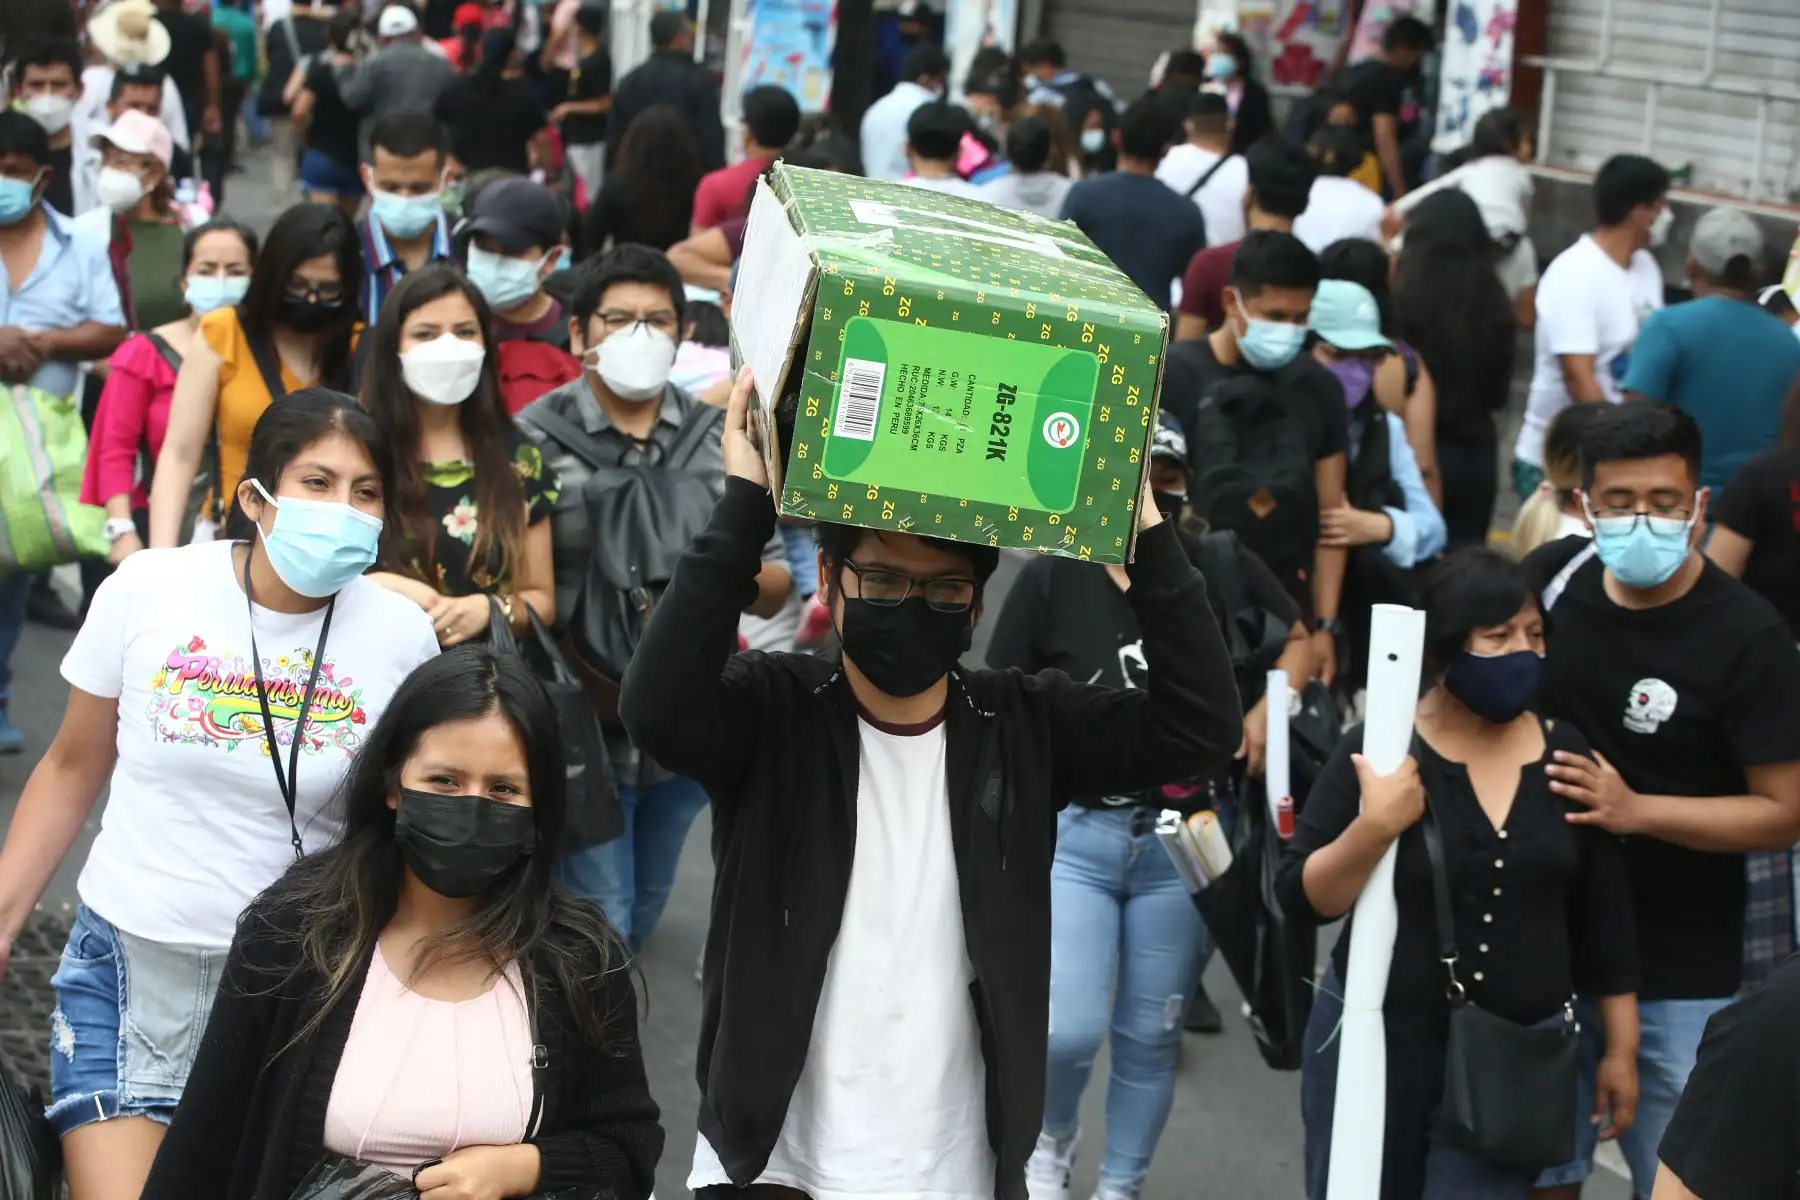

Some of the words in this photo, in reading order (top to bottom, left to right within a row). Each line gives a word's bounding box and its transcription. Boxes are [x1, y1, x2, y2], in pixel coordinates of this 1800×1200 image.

[844, 280, 854, 296] ZG
[883, 276, 896, 296] ZG
[976, 291, 984, 304] ZG
[824, 308, 832, 320] ZG
[859, 300, 869, 316] ZG
[898, 296, 911, 317] ZG
[1026, 302, 1036, 318] ZG
[1067, 304, 1078, 322] ZG
[952, 311, 959, 321] ZG
[992, 312, 1000, 324] ZG
[1041, 324, 1051, 339] ZG
[1082, 322, 1094, 343] ZG
[1134, 334, 1140, 344] ZG
[815, 350, 822, 360] ZG
[1098, 344, 1109, 364] ZG
[1149, 355, 1156, 364] ZG
[897, 364, 908, 393] HECHO
[1112, 365, 1124, 384] ZG
[895, 397, 903, 408] EN
[902, 365, 920, 435] RUC:20463689599
[962, 374, 976, 418] CANTIDAD:
[1126, 386, 1140, 406] ZG
[806, 396, 819, 417] ZG
[910, 367, 931, 451] MEDIDA:7X26X36CM
[945, 408, 952, 417] 14
[1100, 406, 1110, 422] ZG
[890, 412, 900, 435] PERU
[986, 382, 1018, 462] ZG-821K
[926, 432, 935, 449] KGS
[1115, 427, 1125, 442] ZG
[798, 442, 808, 458] ZG
[938, 433, 948, 452] KGS
[956, 438, 965, 454] PZA
[1130, 448, 1140, 463] ZG
[1097, 457, 1106, 470] ZG
[813, 464, 822, 479] ZG
[828, 484, 838, 499] ZG
[1112, 478, 1120, 490] ZG
[921, 494, 927, 503] ZG
[1086, 496, 1094, 506] ZG
[1127, 499, 1134, 511] ZG
[842, 504, 853, 519] ZG
[882, 500, 895, 520] ZG
[1008, 506, 1019, 522] ZG
[936, 514, 942, 524] ZG
[975, 514, 983, 527] ZG
[1101, 516, 1108, 526] ZG
[989, 534, 997, 546] ZG
[1023, 526, 1033, 541] ZG
[1116, 537, 1122, 546] ZG
[167, 649, 354, 713] Peruanisima
